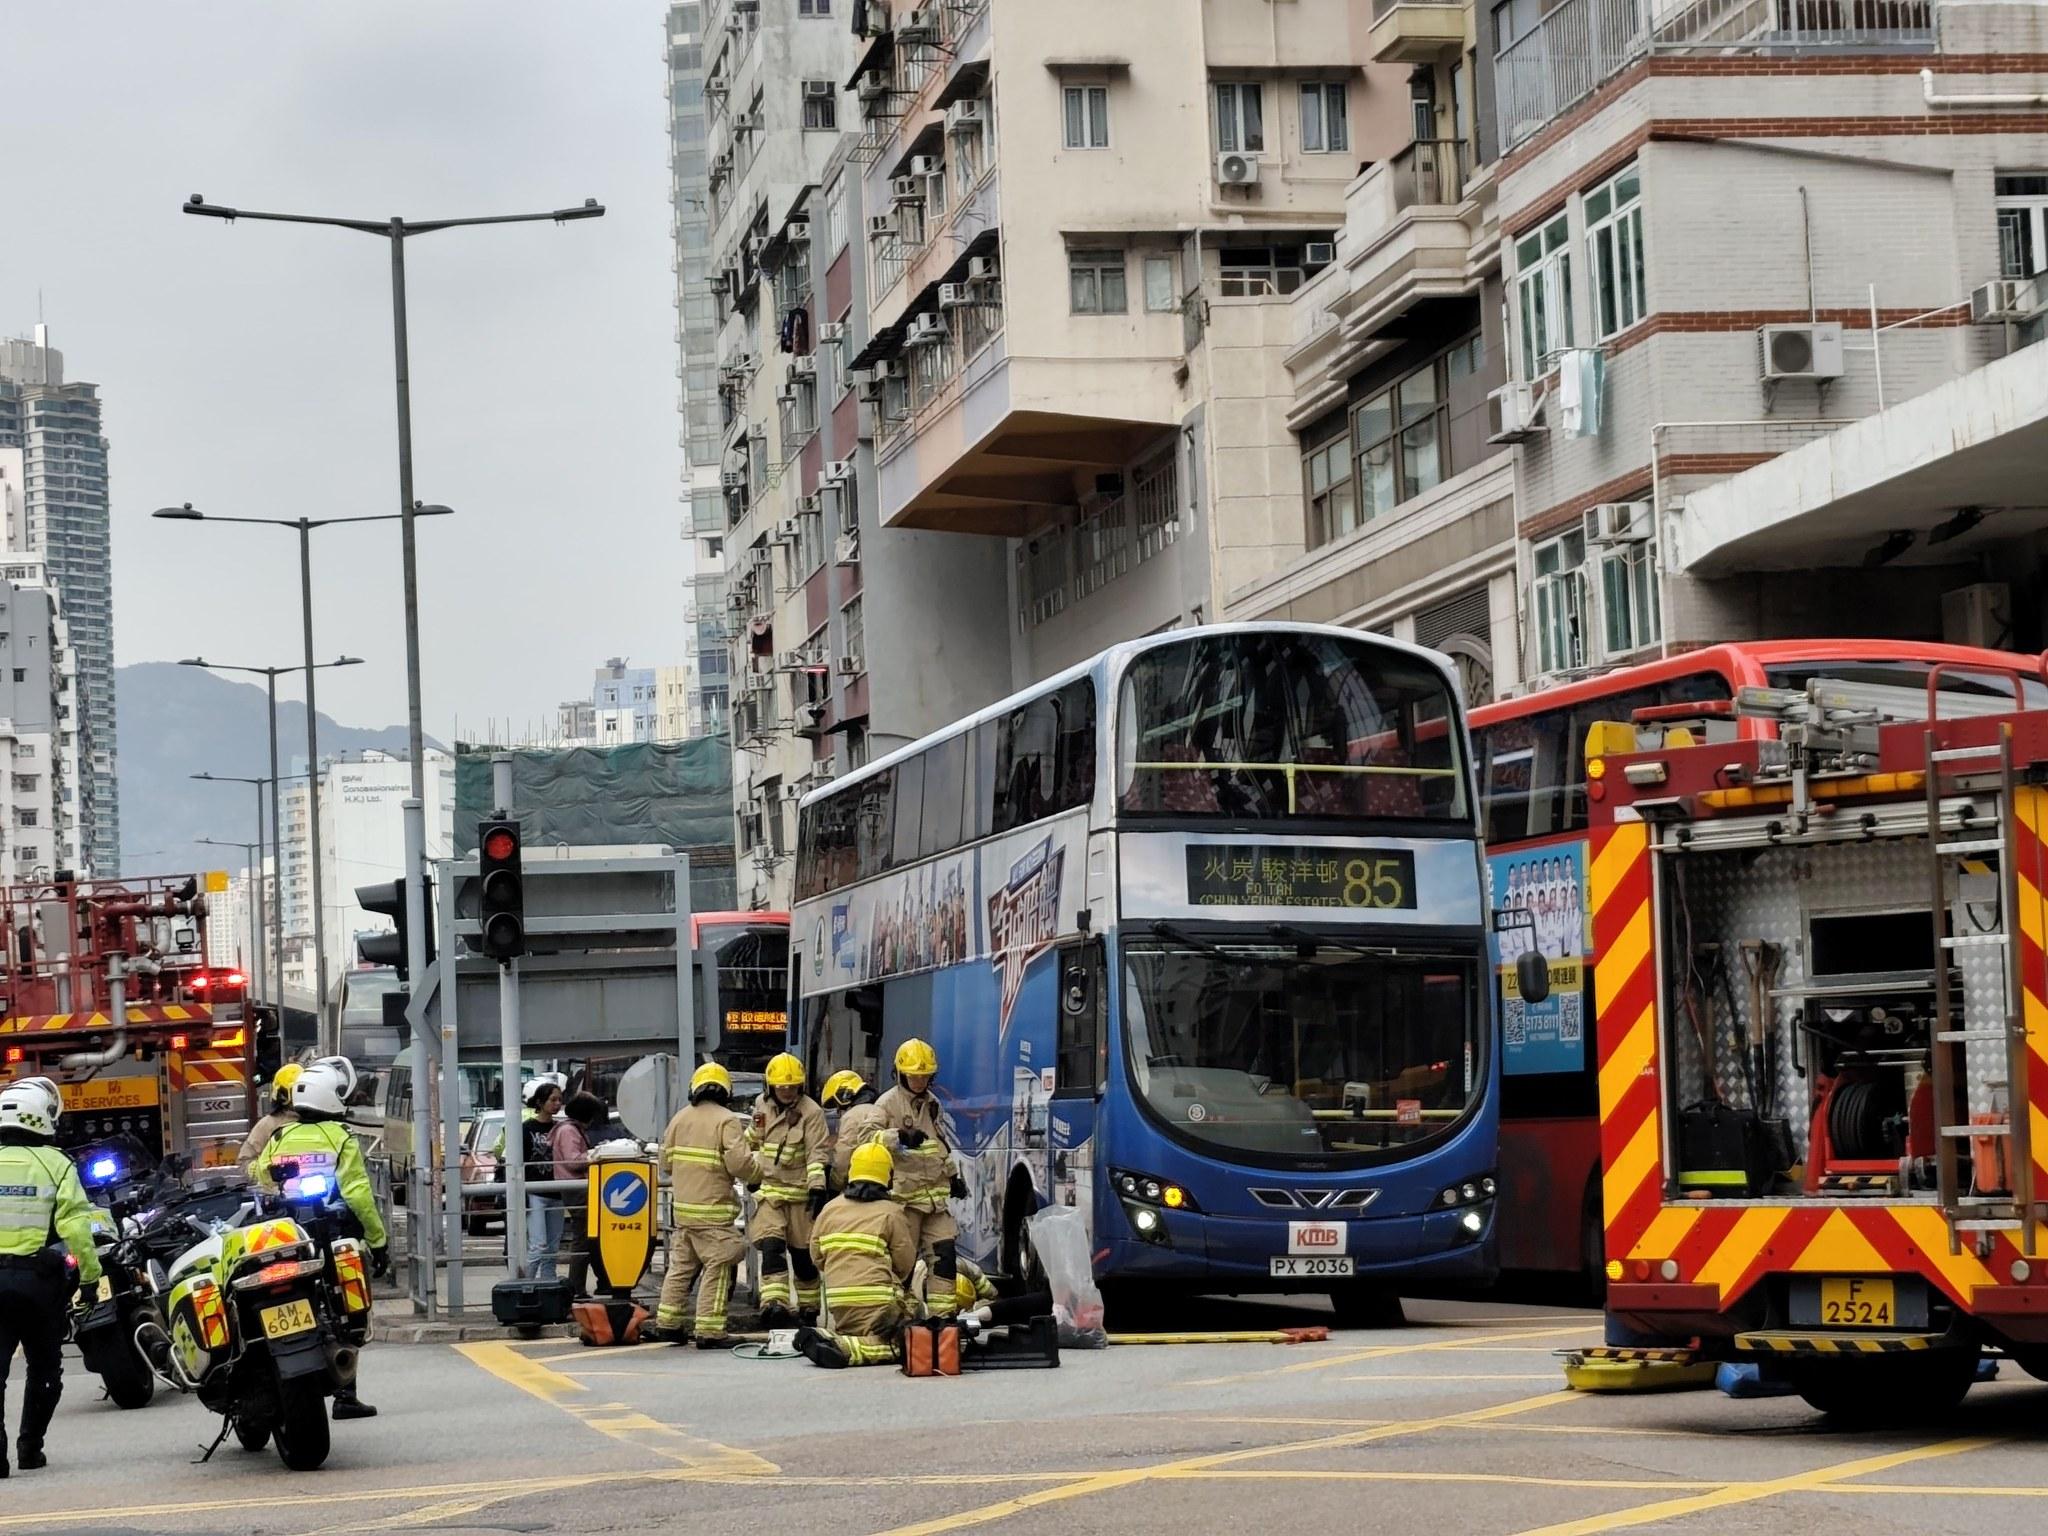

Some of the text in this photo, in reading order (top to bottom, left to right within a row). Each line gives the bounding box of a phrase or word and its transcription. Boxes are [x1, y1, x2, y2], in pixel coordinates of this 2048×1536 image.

[1204, 857, 1338, 884] 火炭駿洋邨
[1246, 883, 1292, 896] FO TAN
[1343, 859, 1402, 908] 85
[1526, 1015, 1543, 1031] 5175
[63, 1094, 140, 1109] RE SERVICES
[610, 1223, 642, 1231] 7042
[1297, 1228, 1338, 1246] KMB
[1275, 1259, 1349, 1275] PX 2036
[1849, 1279, 1865, 1301] F
[277, 1303, 298, 1321] AM
[1826, 1301, 1889, 1324] 2524
[268, 1312, 313, 1334] 6044
